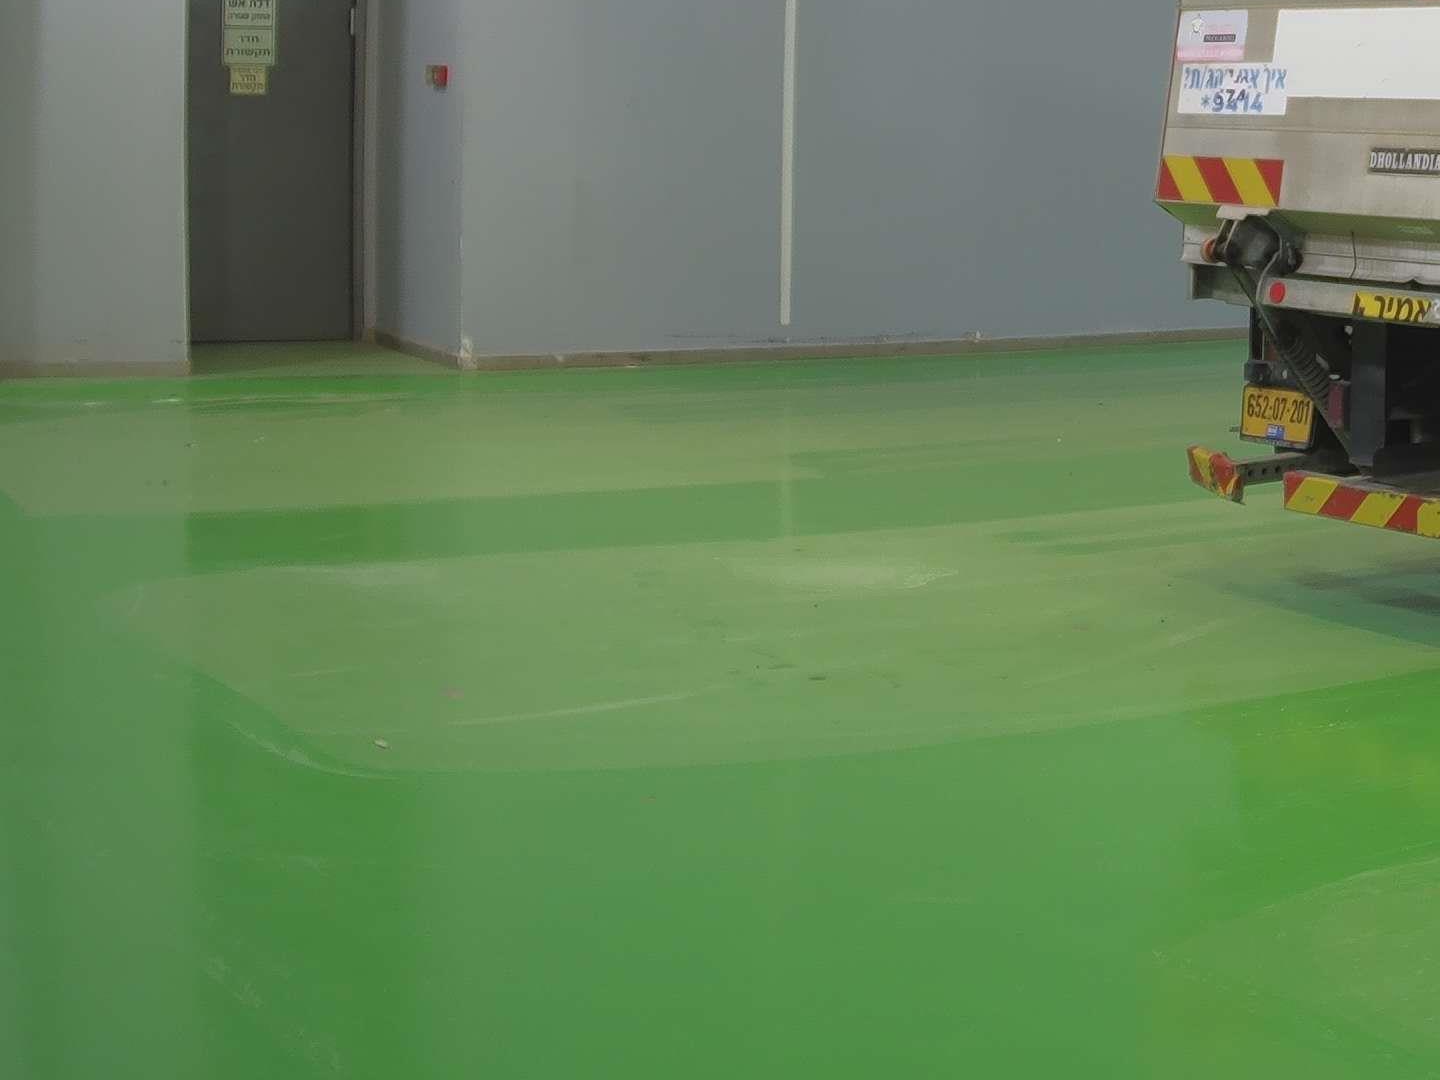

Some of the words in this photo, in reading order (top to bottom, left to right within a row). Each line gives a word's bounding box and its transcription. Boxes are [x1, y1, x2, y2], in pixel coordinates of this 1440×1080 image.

[228, 0, 246, 8] אש
[1369, 151, 1440, 171] DHOLLANDIA
[1374, 296, 1432, 322] אמיר
